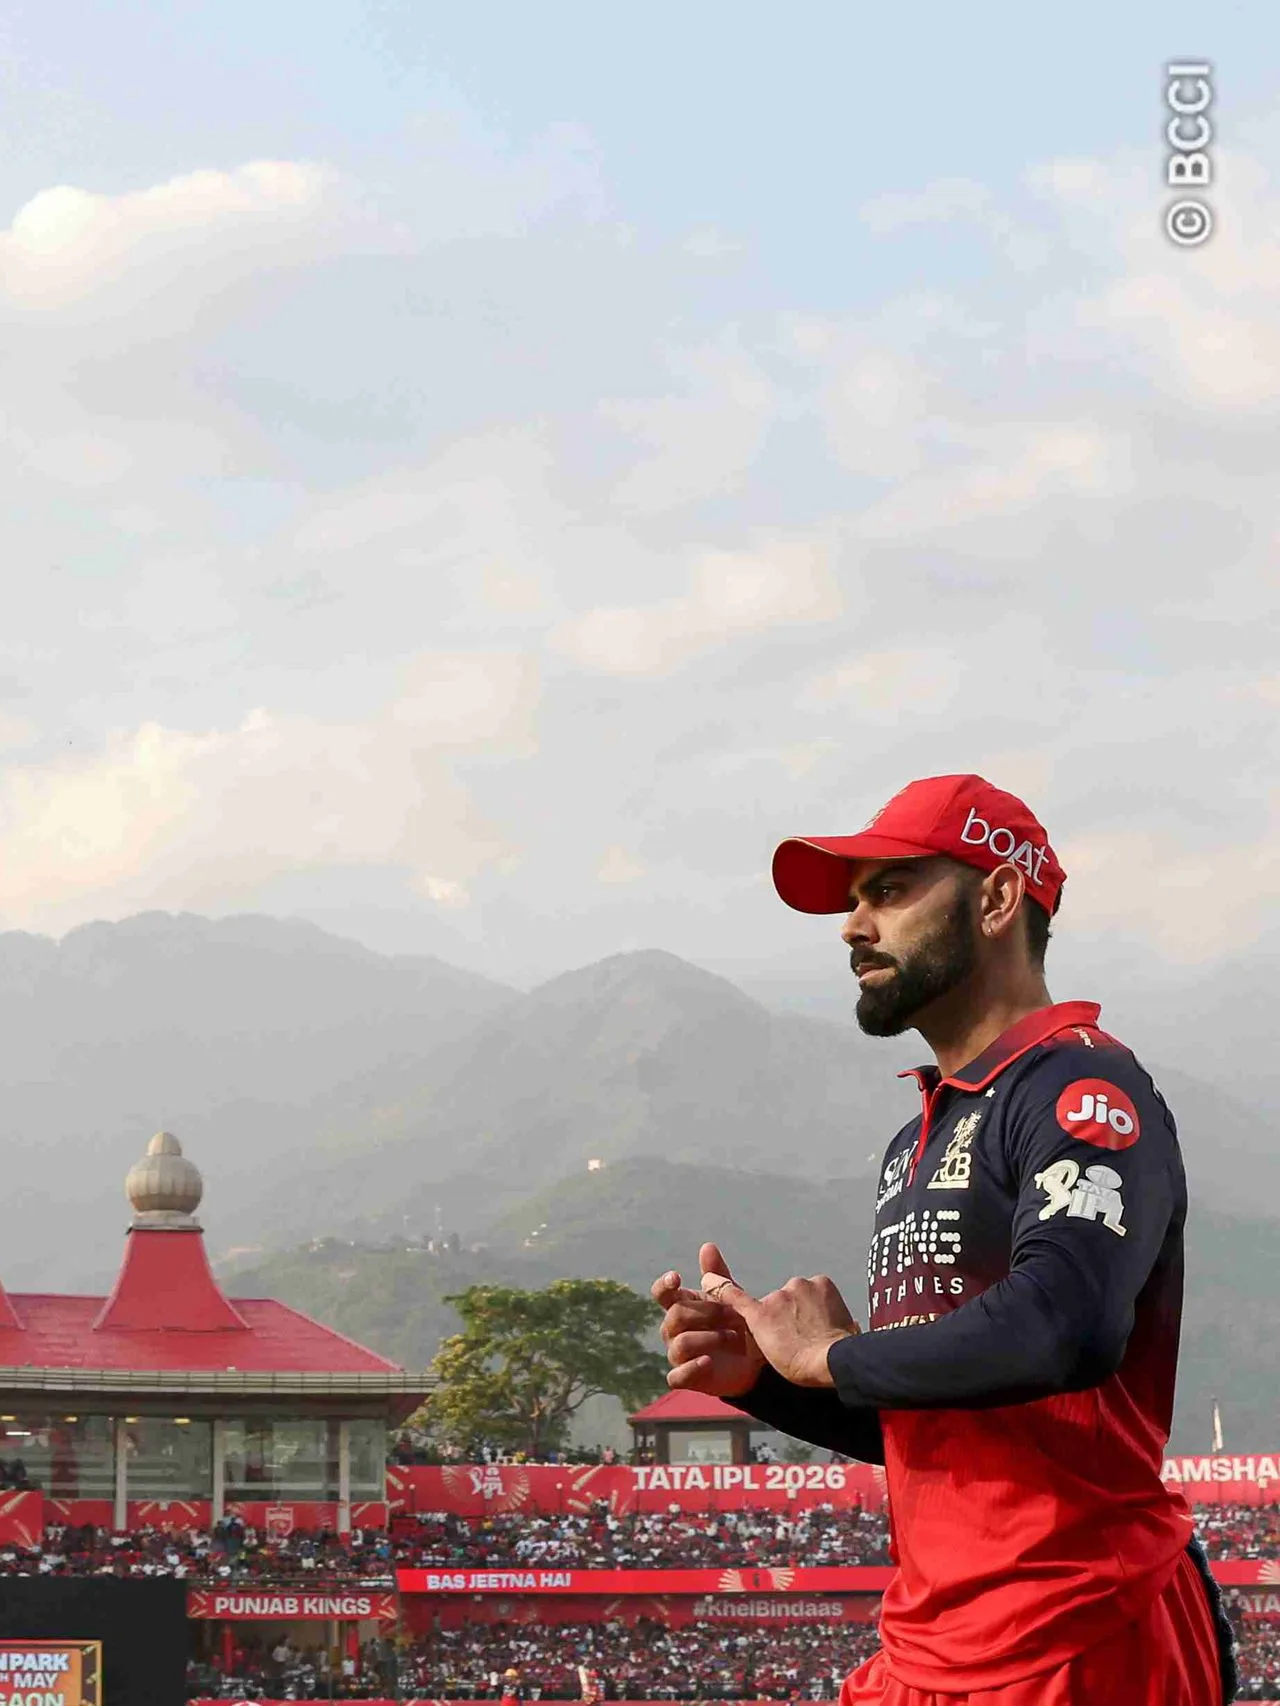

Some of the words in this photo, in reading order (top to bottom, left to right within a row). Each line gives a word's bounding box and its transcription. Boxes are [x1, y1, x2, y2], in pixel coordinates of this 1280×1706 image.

[1067, 1094, 1134, 1135] Jio
[1161, 1456, 1280, 1482] AMSHA
[633, 1467, 705, 1491] TATA
[714, 1467, 760, 1490] IPL
[765, 1466, 846, 1490] 2026
[427, 1575, 464, 1589] BAS
[469, 1574, 536, 1588] JEETNA
[540, 1573, 570, 1587] HAI
[215, 1597, 298, 1614] PUNJAB
[303, 1597, 371, 1614] KINGS
[692, 1599, 843, 1617] #KhelBindaas
[13, 1673, 58, 1688] MAY
